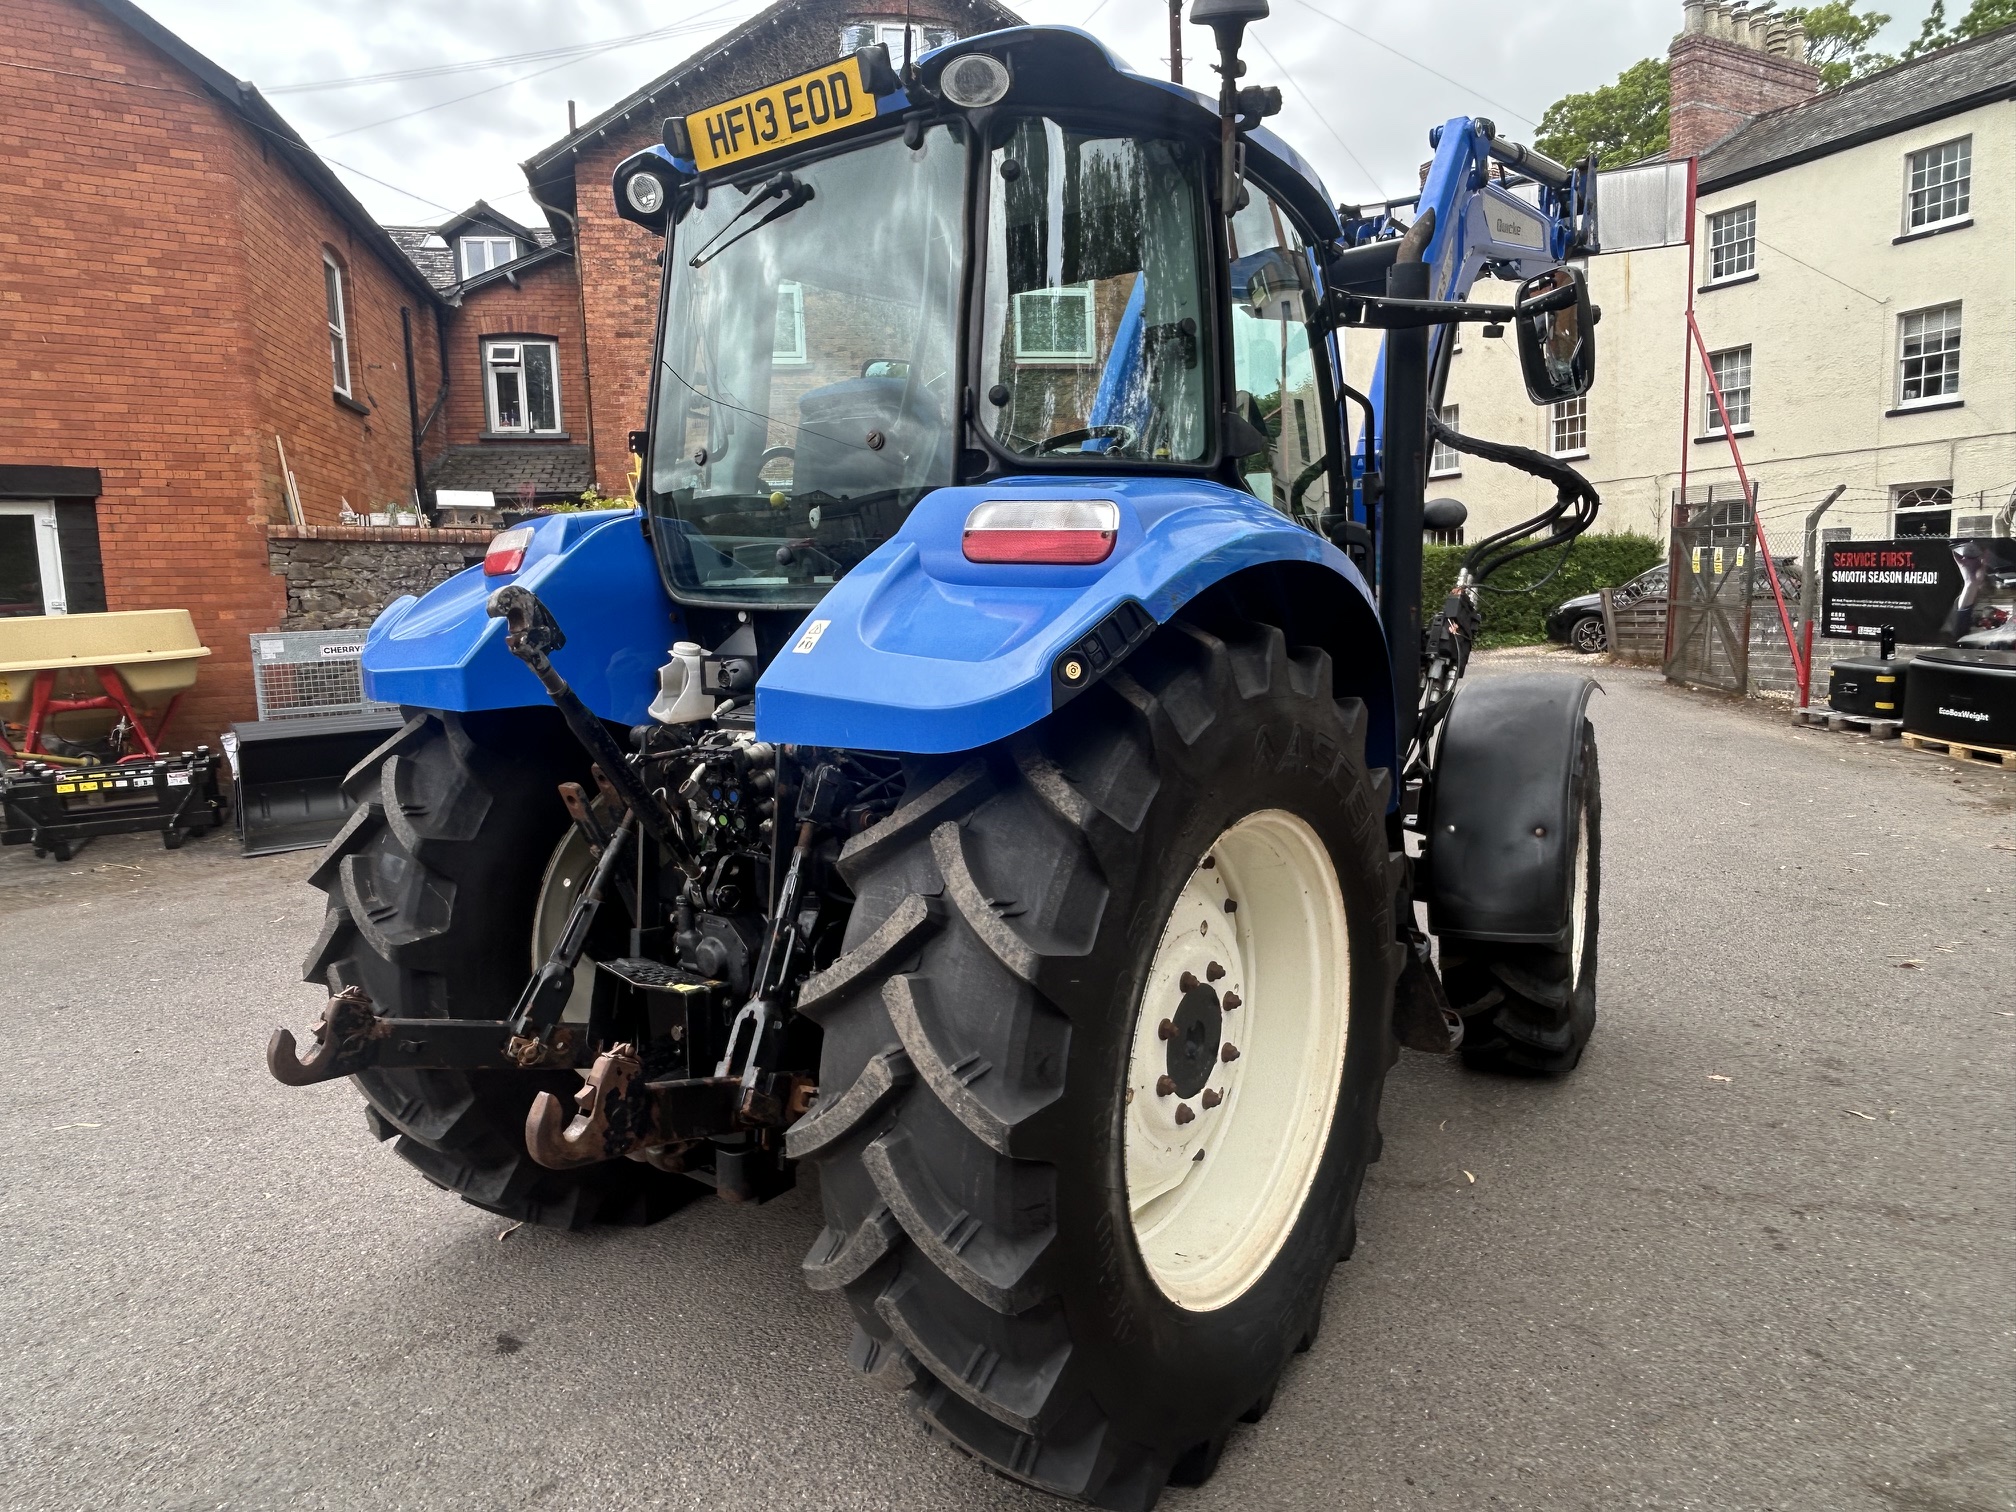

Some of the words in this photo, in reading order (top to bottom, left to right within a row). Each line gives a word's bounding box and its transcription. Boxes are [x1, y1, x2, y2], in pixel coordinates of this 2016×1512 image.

[705, 97, 779, 159] HF13
[783, 71, 853, 134] EOD
[1833, 552, 1877, 567] SERVICE
[1880, 551, 1915, 569] FIRST,
[1832, 570, 1867, 583] SMOOTH
[1868, 571, 1902, 583] SEASON
[1904, 571, 1938, 585] AHEAD!
[1939, 706, 1990, 722] EcoBoxWeight
